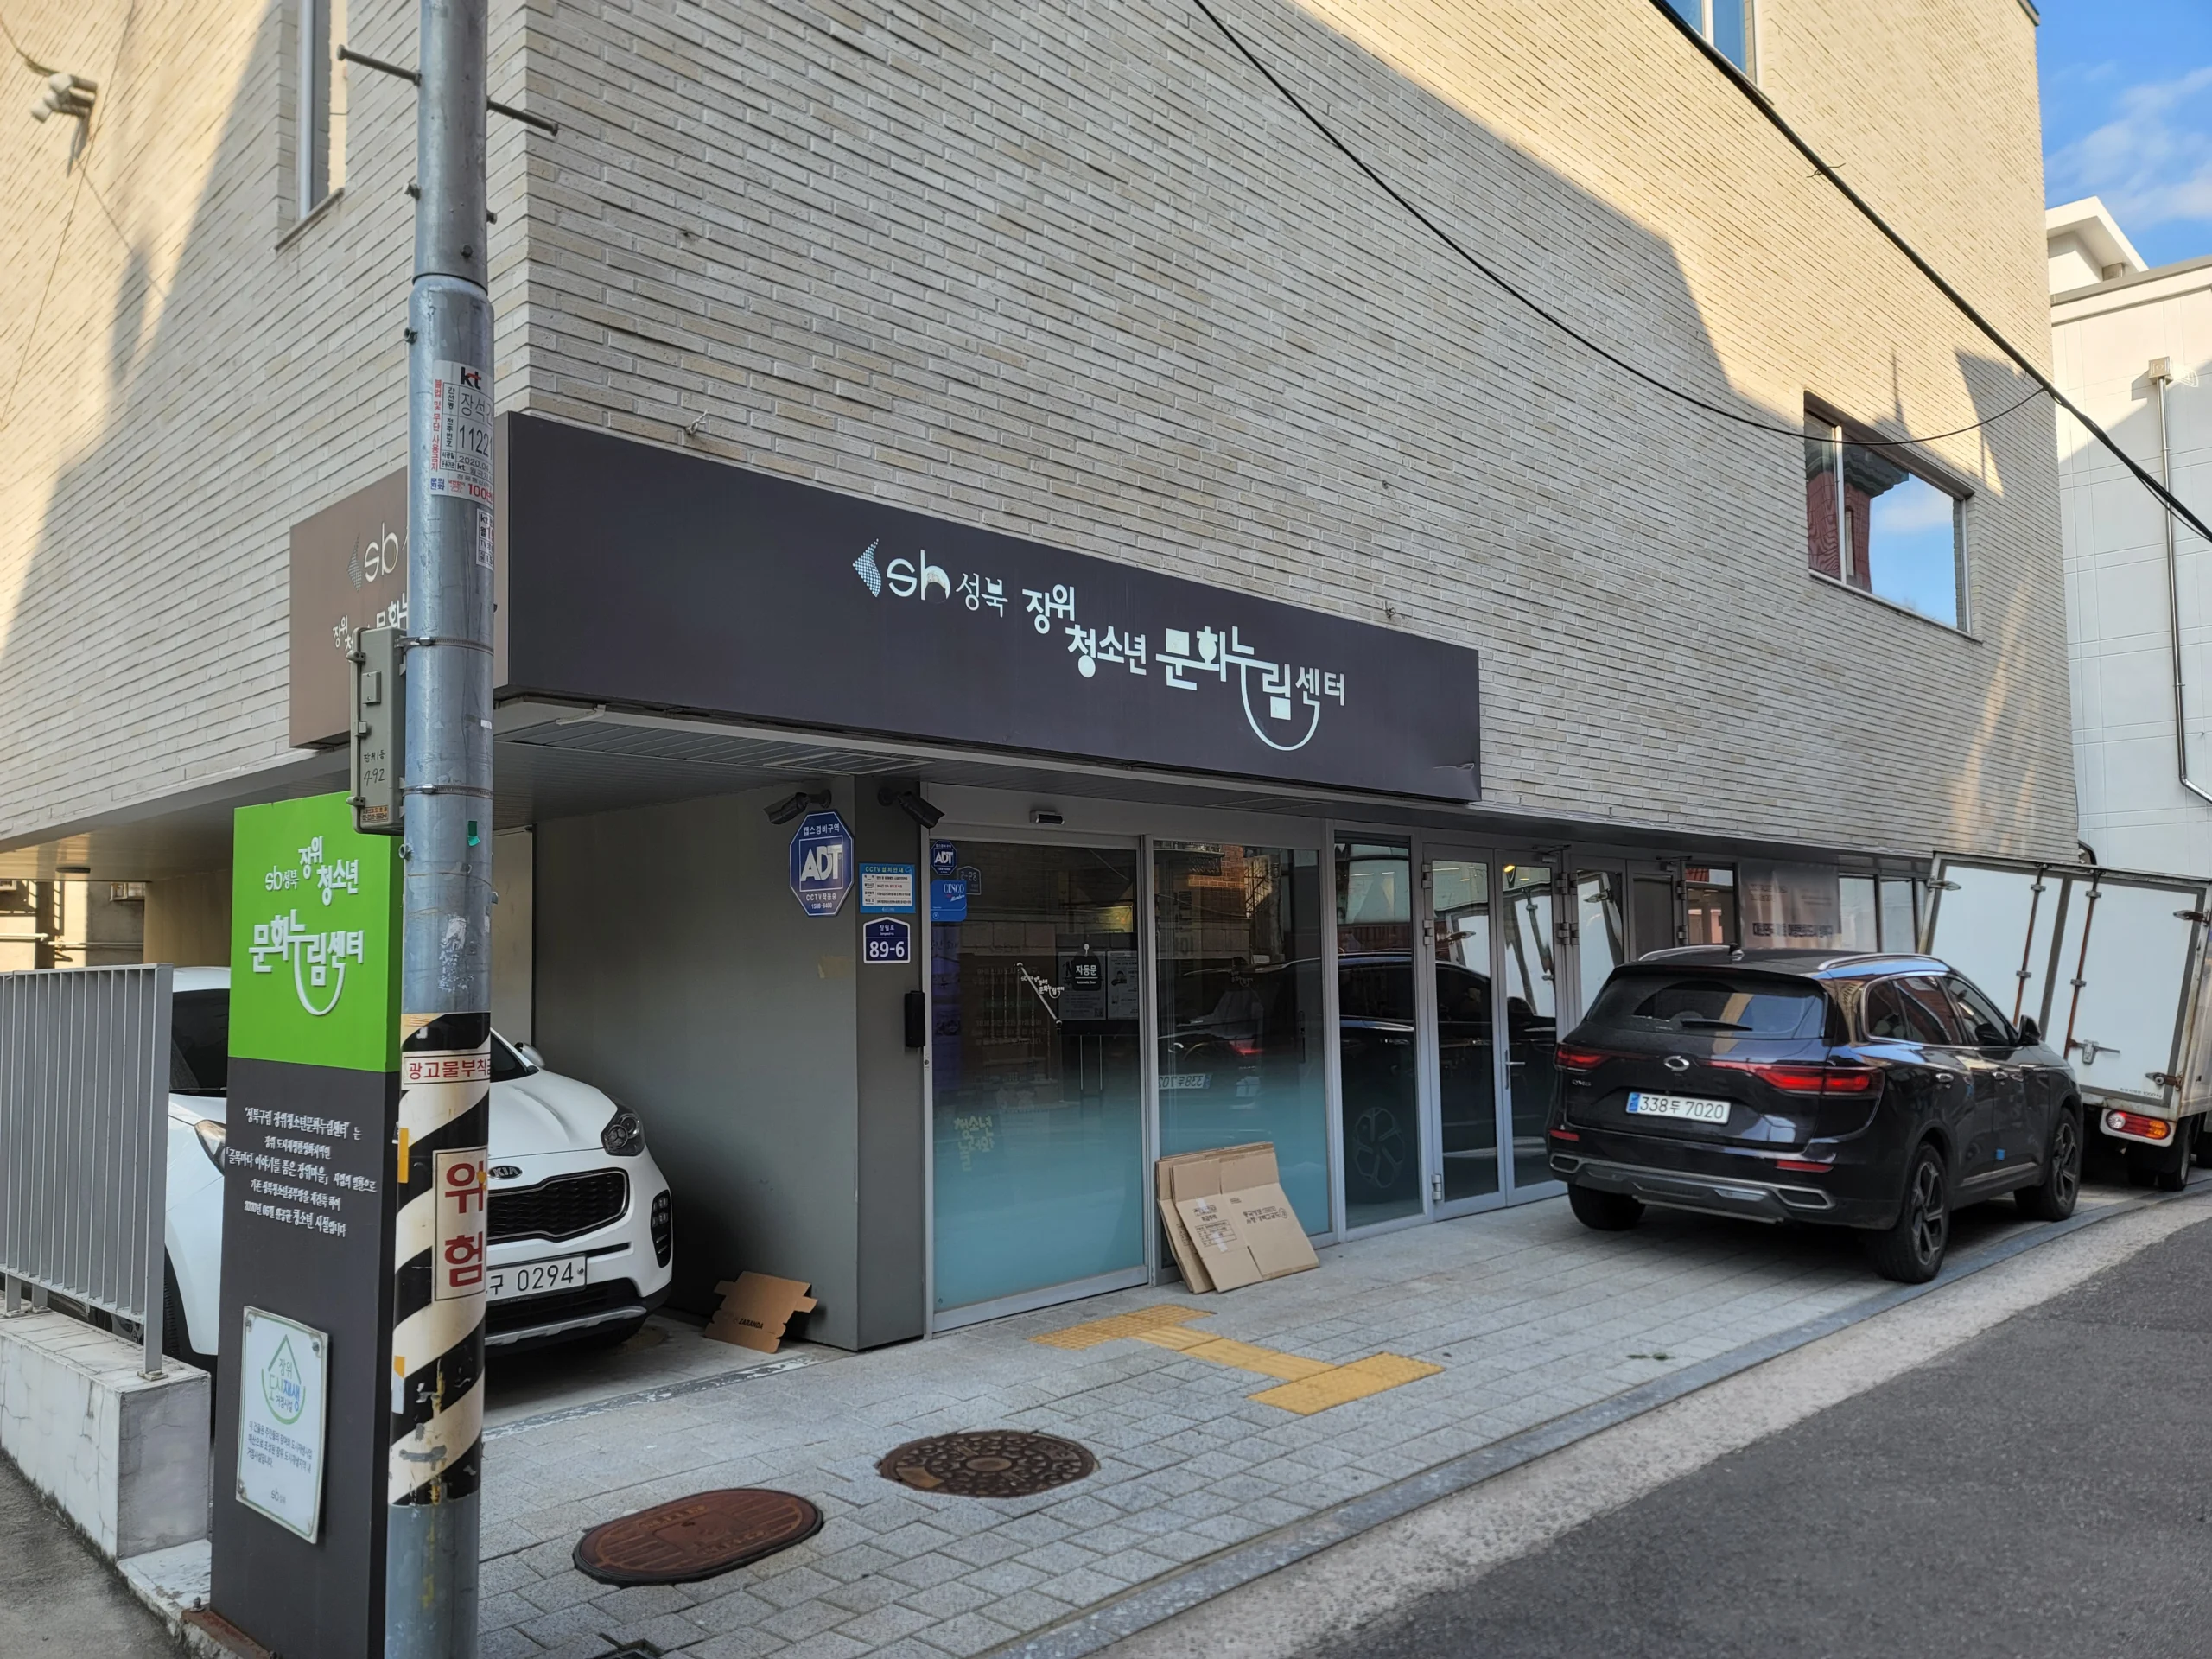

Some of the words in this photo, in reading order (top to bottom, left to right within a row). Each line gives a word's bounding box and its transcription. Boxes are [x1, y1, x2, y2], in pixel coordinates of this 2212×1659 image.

[461, 366, 481, 391] kt
[956, 573, 1009, 618] 성북
[1022, 584, 1075, 634] 장위
[1065, 624, 1147, 677] 청소년
[364, 768, 386, 786] 492
[803, 823, 840, 836] 캡스경비구역
[298, 836, 324, 880] 장위
[800, 844, 842, 882] ADT
[934, 850, 953, 865] ADT
[317, 859, 359, 906] 청소년
[943, 883, 965, 893] CESCO
[869, 941, 905, 958] 89-6
[1075, 964, 1097, 976] 자동문
[1639, 1096, 1681, 1116] 338두
[1685, 1100, 1725, 1120] 7020
[491, 1166, 522, 1178] KIA
[293, 1208, 315, 1229] 청소년
[444, 1160, 484, 1289] 위험
[517, 1262, 574, 1292] 0294
[738, 1318, 764, 1330] ZARANDA
[279, 1357, 293, 1380] 장위
